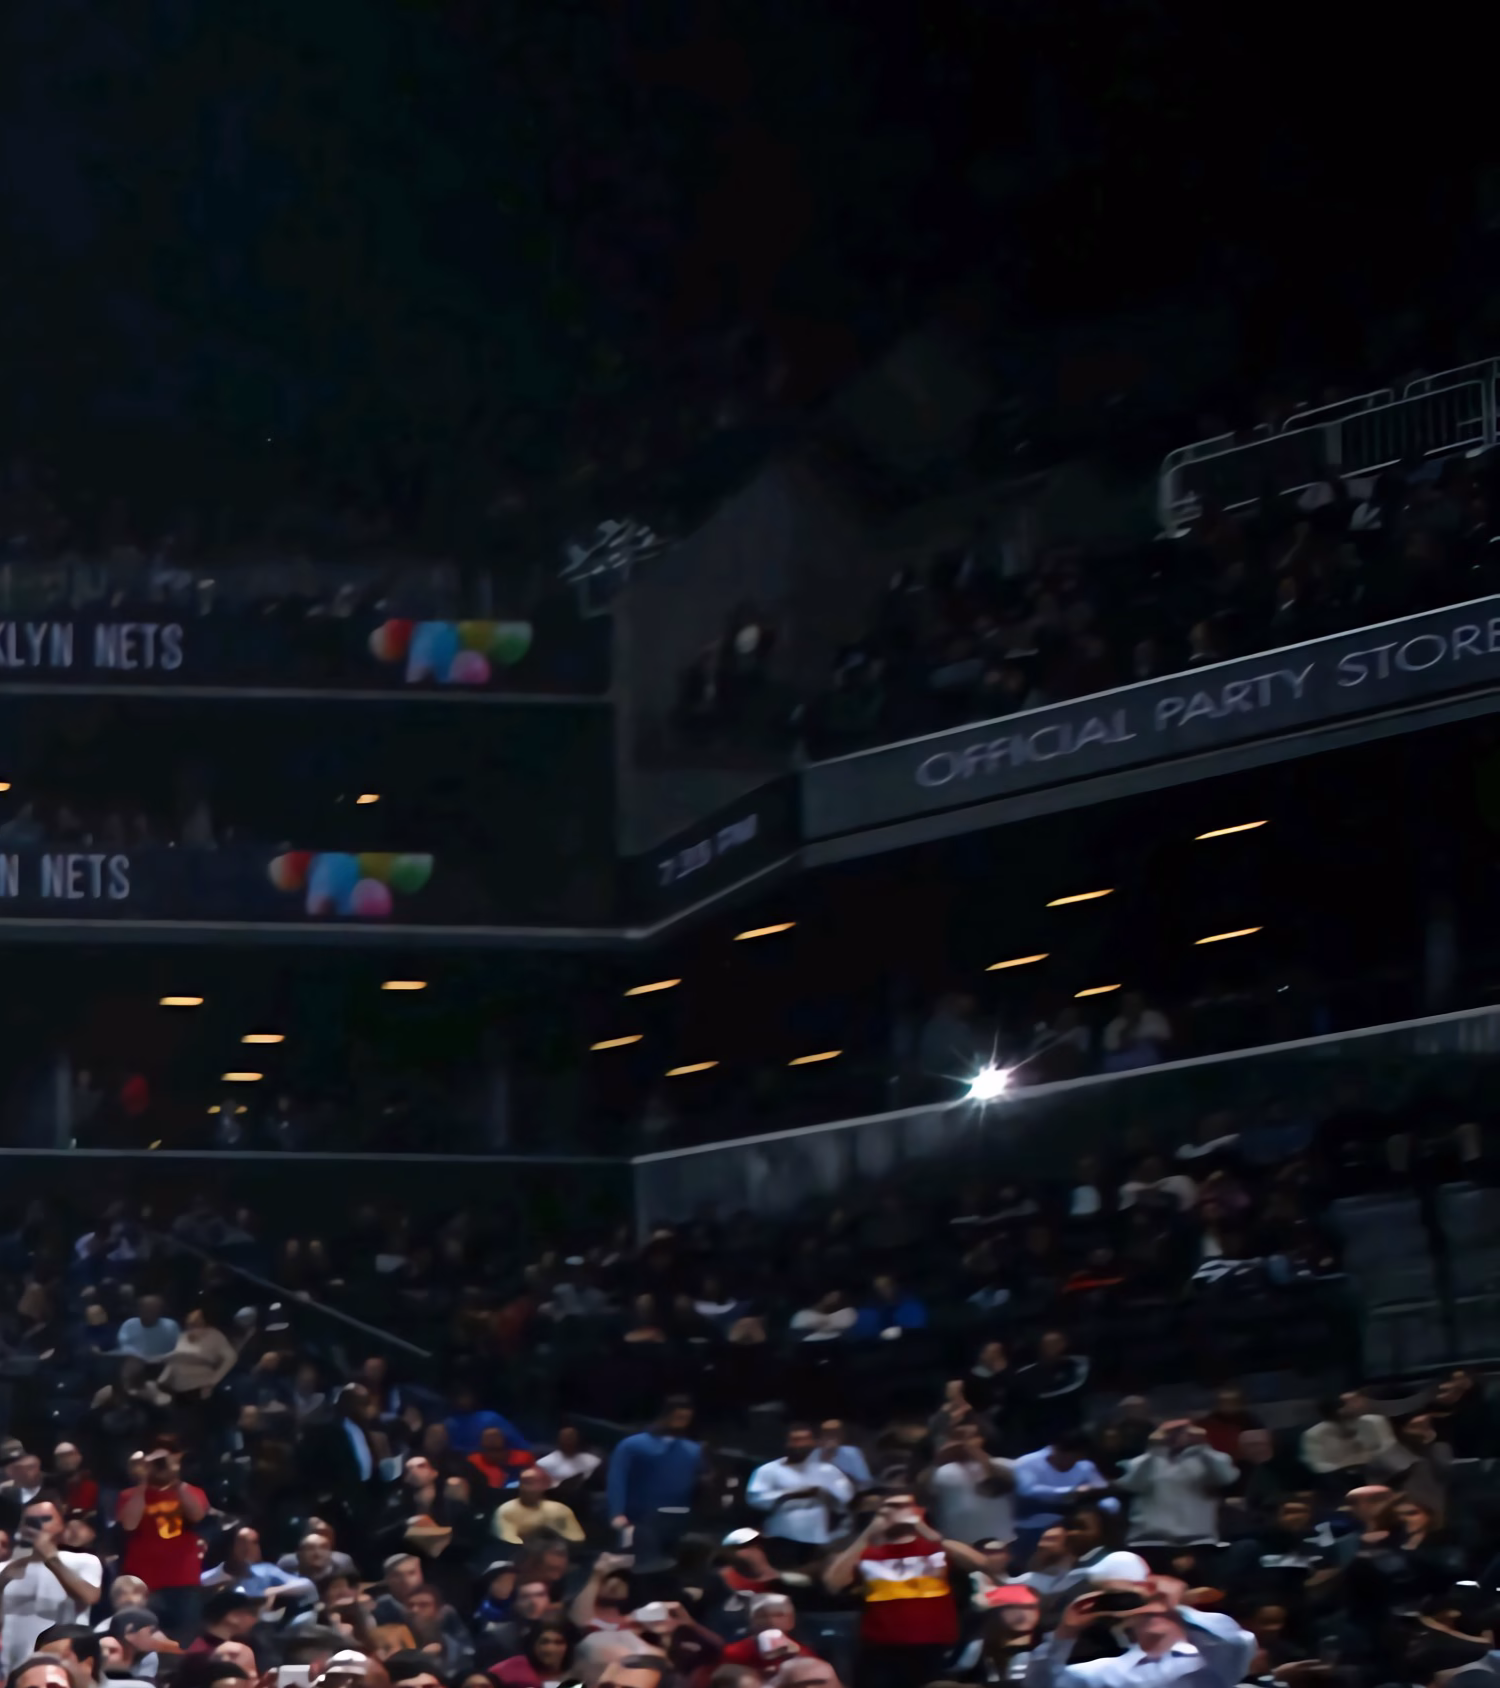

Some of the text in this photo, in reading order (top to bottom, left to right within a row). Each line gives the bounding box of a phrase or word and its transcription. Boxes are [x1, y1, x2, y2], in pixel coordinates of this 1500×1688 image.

[96, 621, 184, 670] NETS
[916, 708, 1137, 787] OFFICIAL
[1155, 662, 1314, 732] PARTY
[41, 852, 130, 900] NETS
